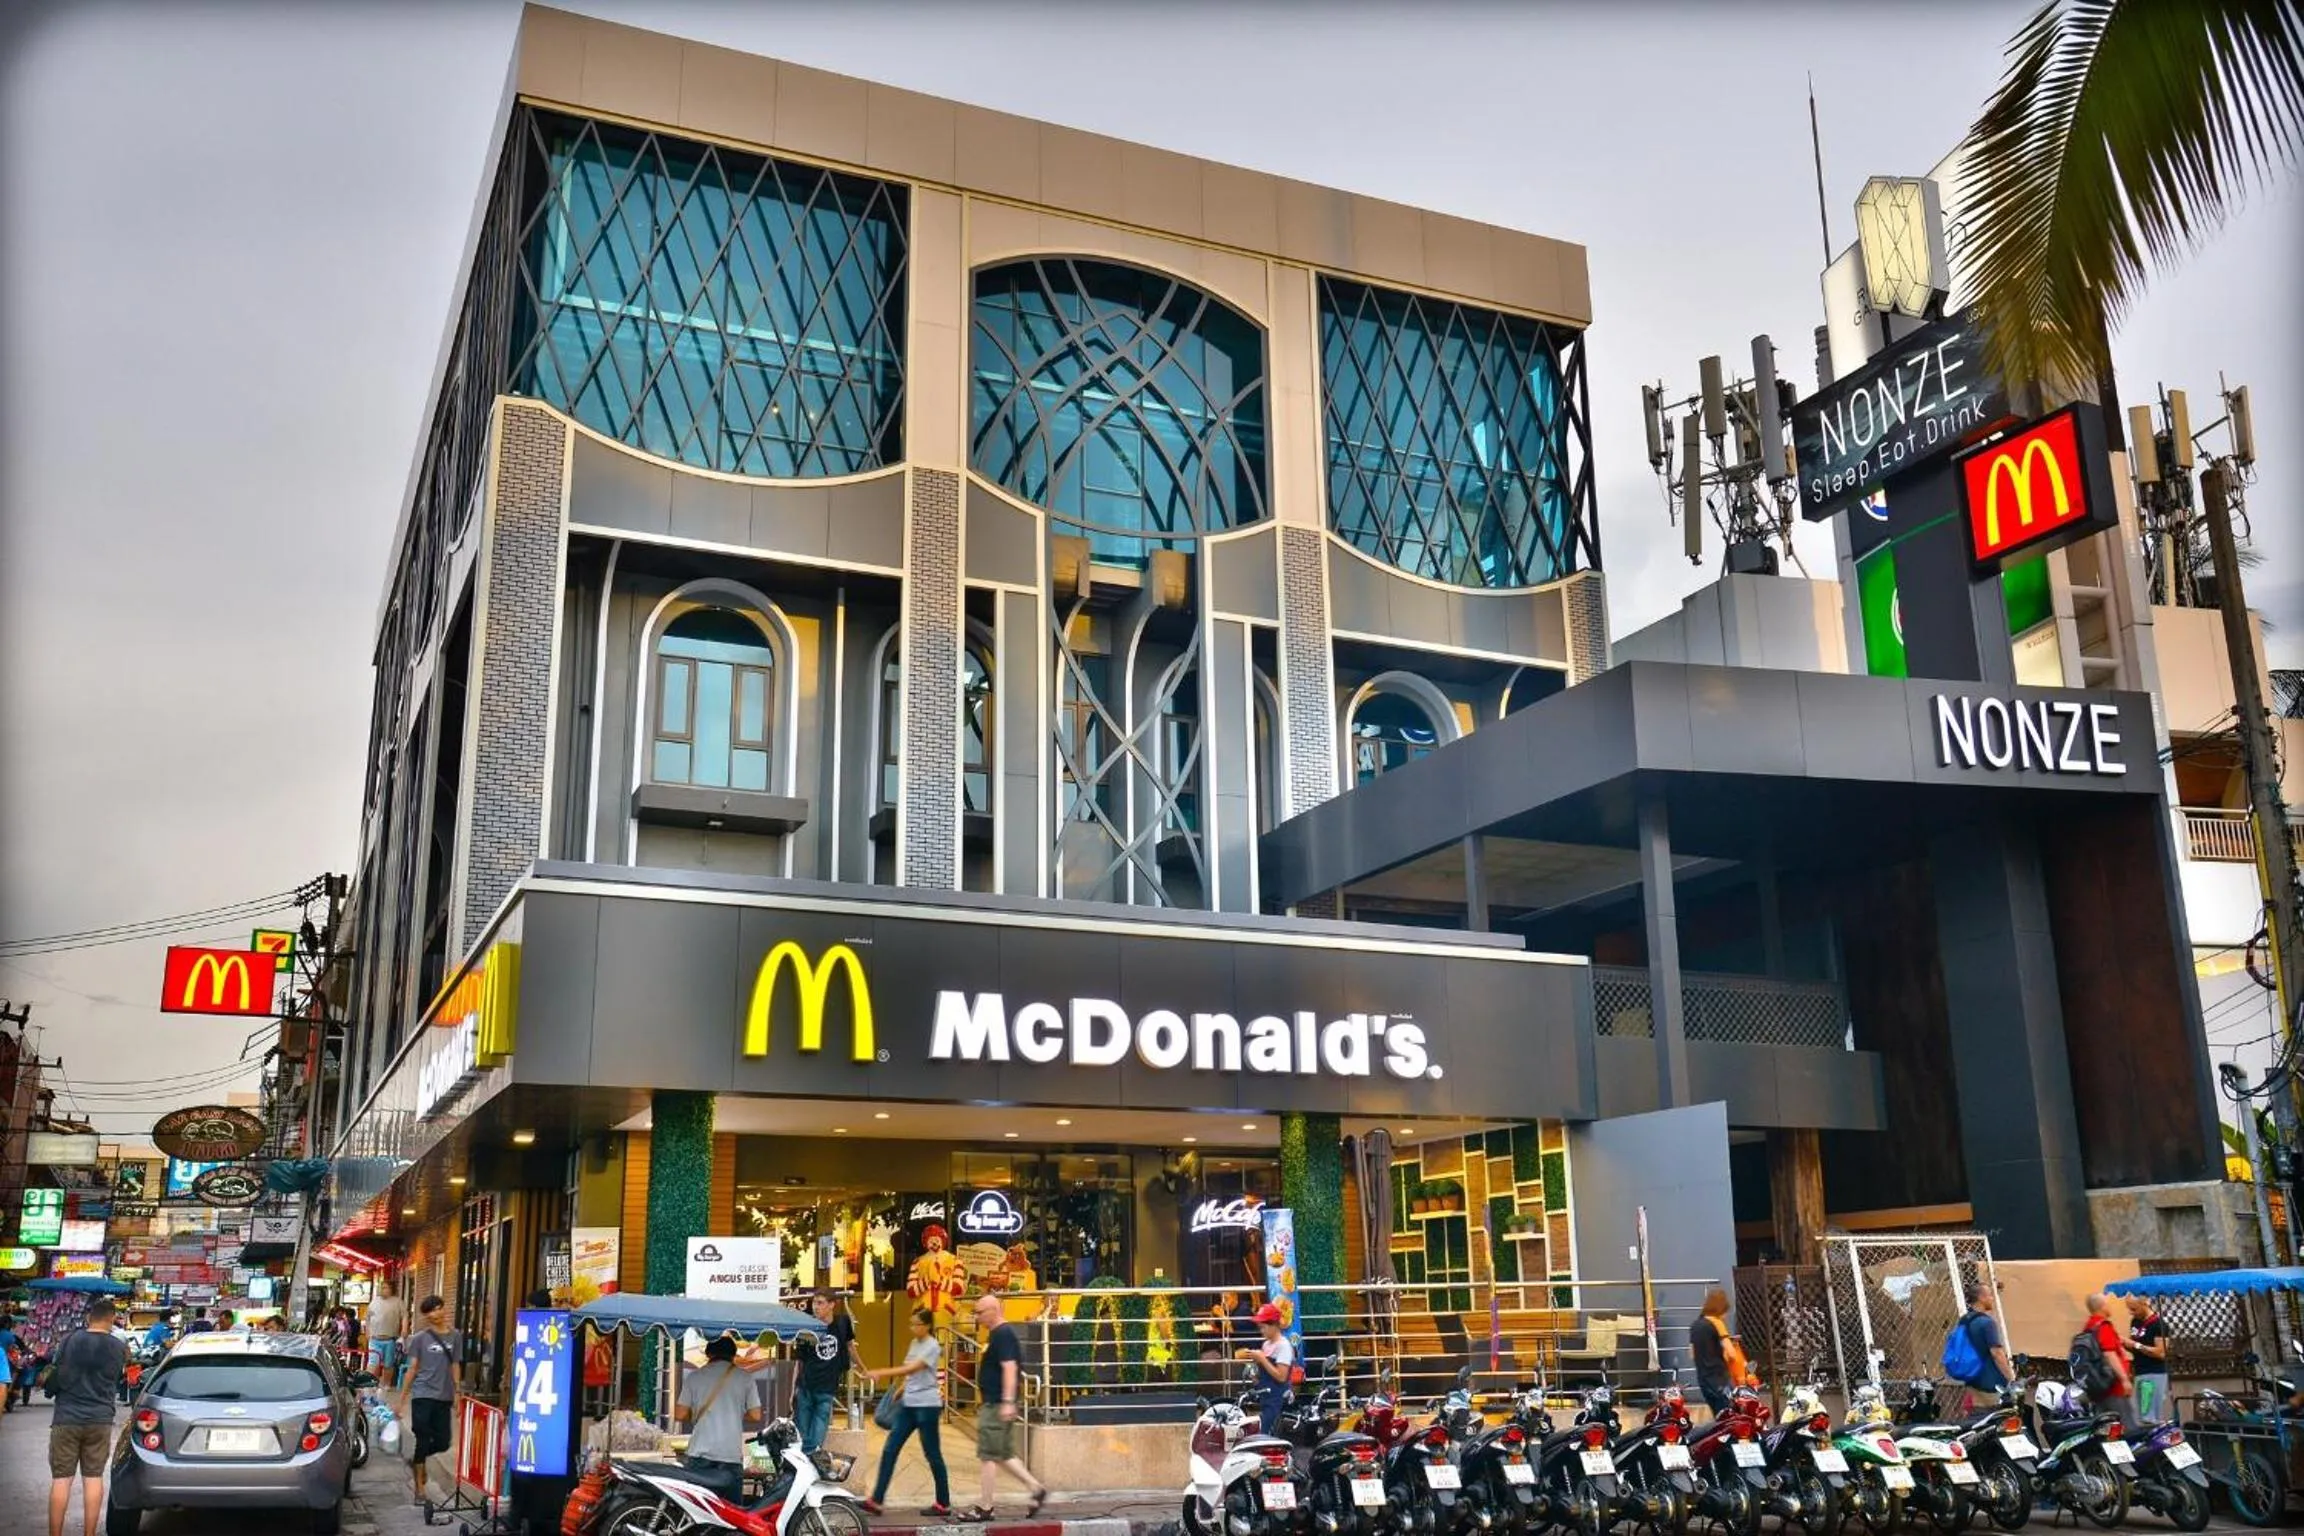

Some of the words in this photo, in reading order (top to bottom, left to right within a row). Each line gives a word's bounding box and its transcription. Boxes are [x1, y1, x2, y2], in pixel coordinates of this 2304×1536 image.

[1820, 334, 1967, 465] NONZE
[1937, 694, 2127, 774] NONZE
[709, 1274, 743, 1283] ANGUS
[744, 1274, 769, 1283] BEEF
[514, 1358, 558, 1416] 24
